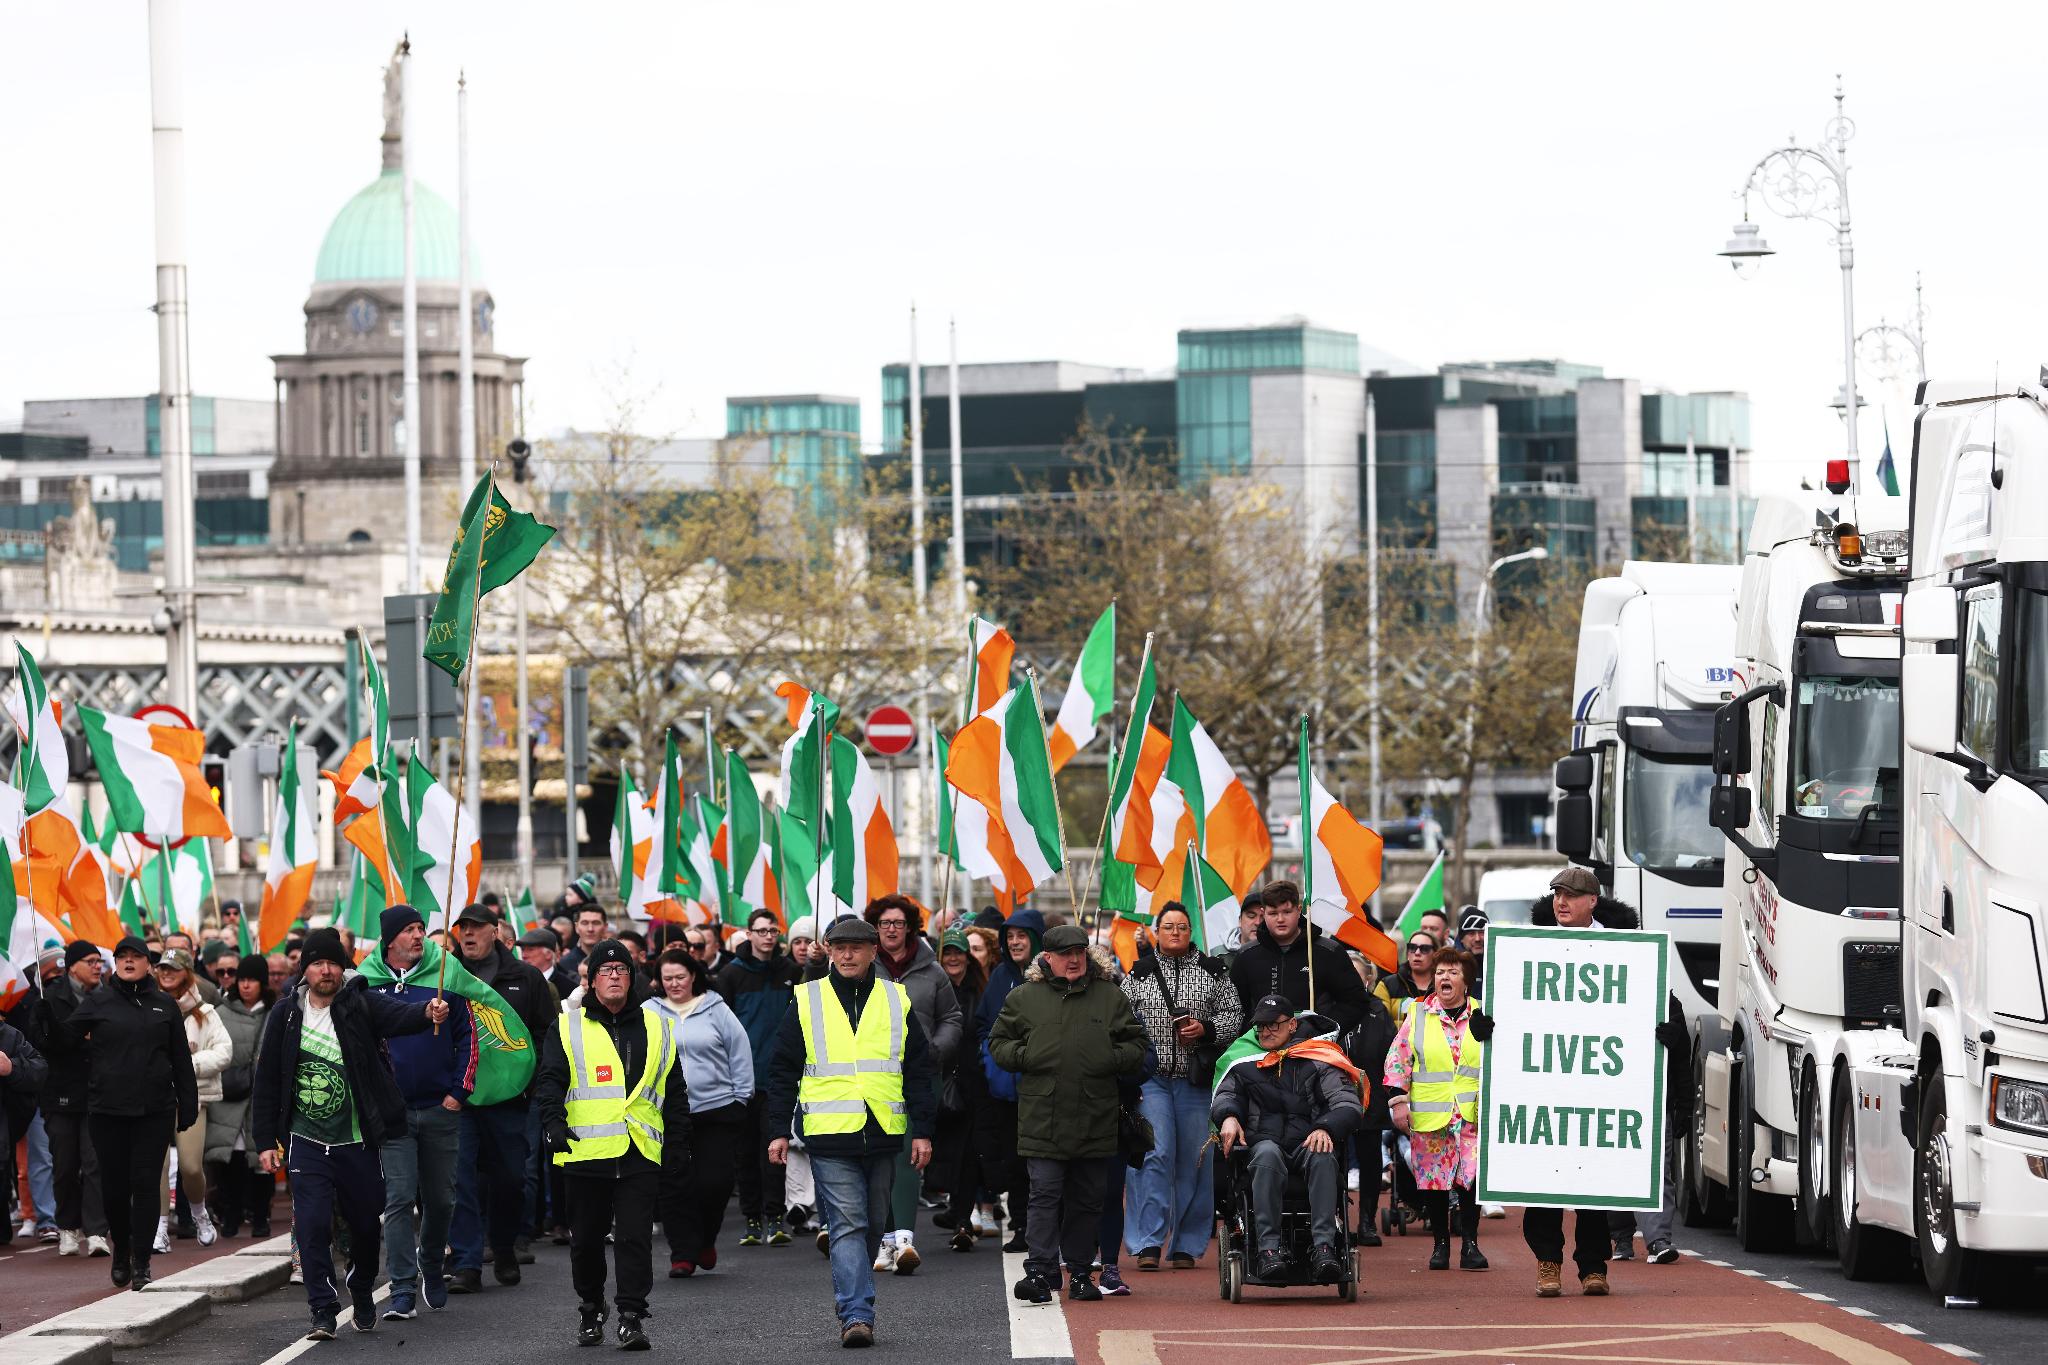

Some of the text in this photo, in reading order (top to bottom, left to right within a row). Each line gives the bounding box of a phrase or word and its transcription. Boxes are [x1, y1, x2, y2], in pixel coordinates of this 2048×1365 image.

[1852, 944, 1901, 954] VOLV
[1523, 961, 1628, 1004] IRISH
[1522, 1033, 1624, 1076] LIVES
[1498, 1103, 1643, 1149] MATTER
